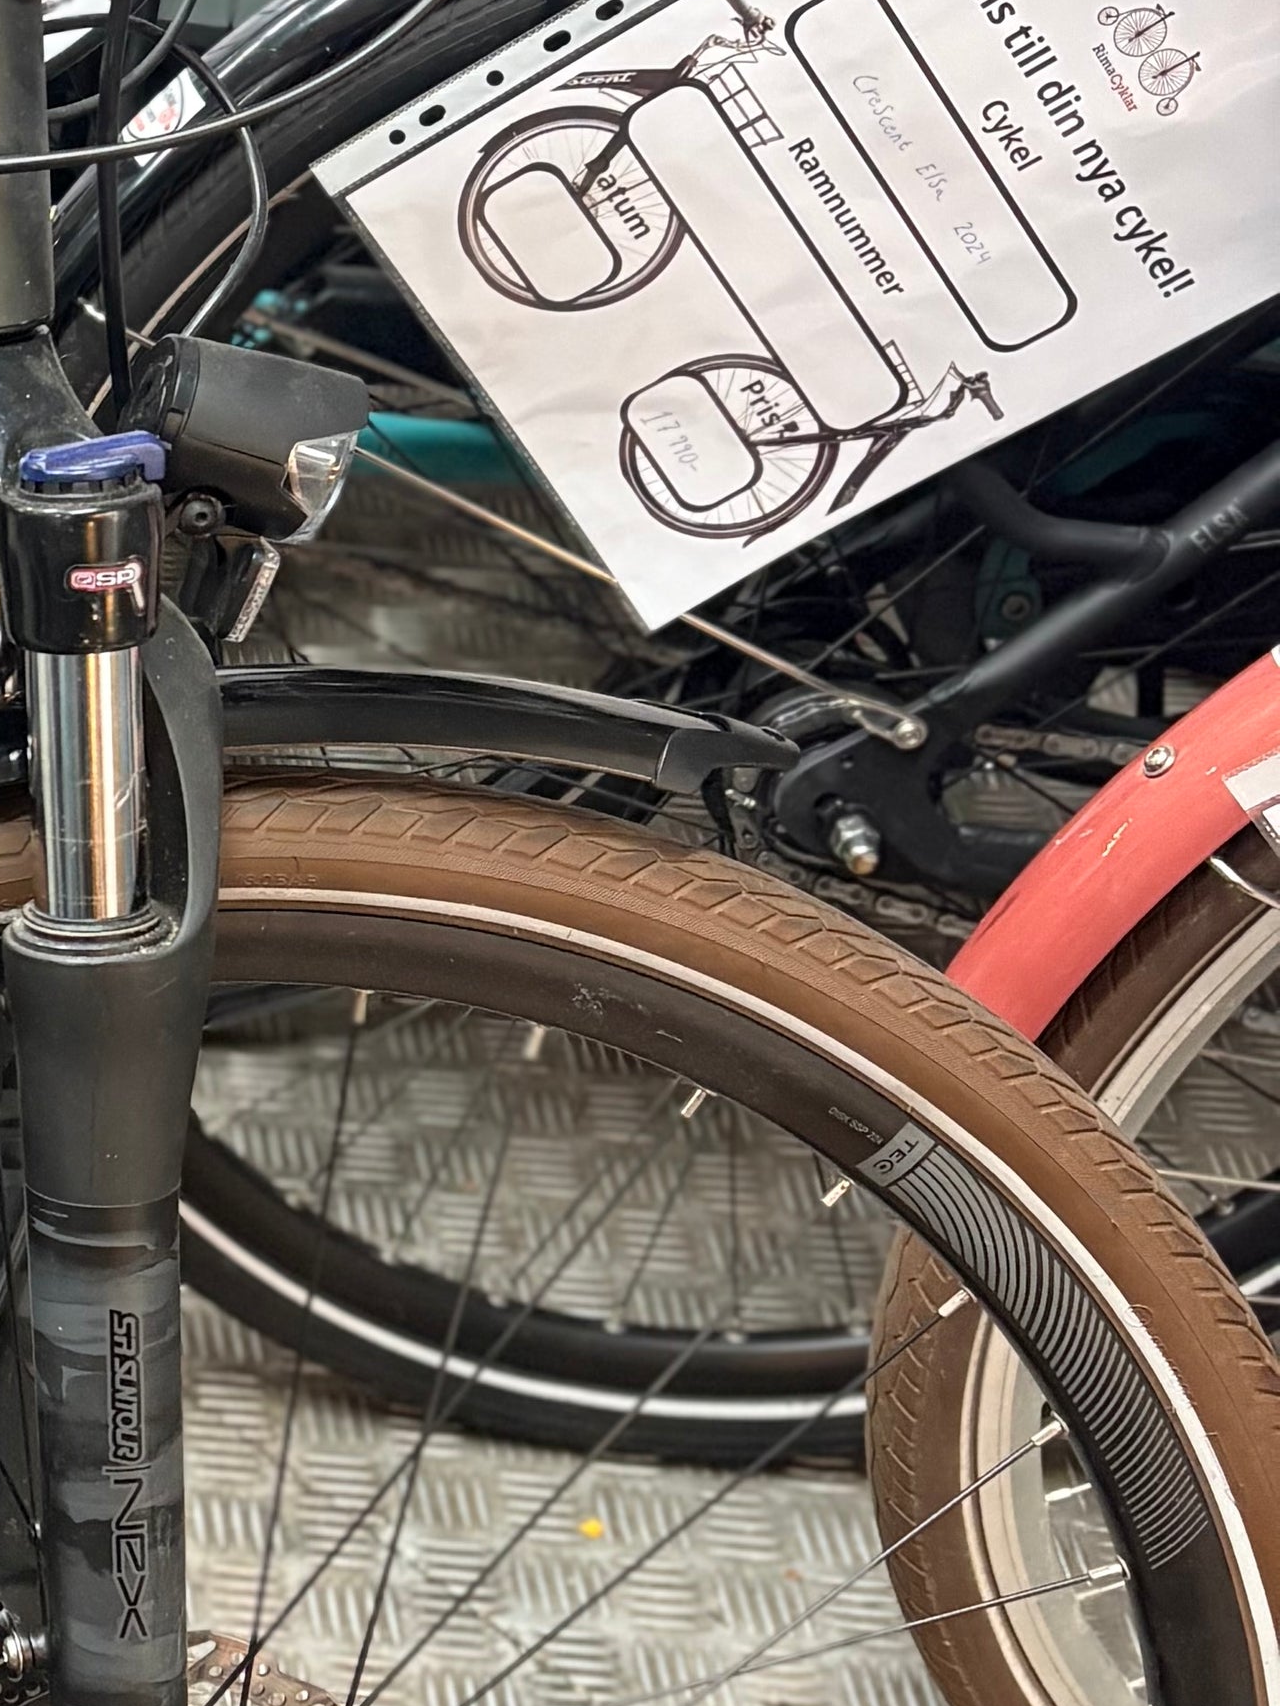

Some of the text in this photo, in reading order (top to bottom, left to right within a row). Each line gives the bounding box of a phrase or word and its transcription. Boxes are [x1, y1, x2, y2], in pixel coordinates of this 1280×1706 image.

[1091, 42, 1138, 112] RimaCyklar
[981, 99, 1043, 172] Cykel
[1003, 24, 1058, 79] till
[1036, 80, 1087, 139] din
[1072, 138, 1127, 203] nya
[1112, 204, 1196, 299] cykel!
[596, 173, 651, 240] atum
[787, 136, 905, 296] Ramnummer
[952, 221, 992, 265] 2024
[873, 1140, 919, 1174] TEC
